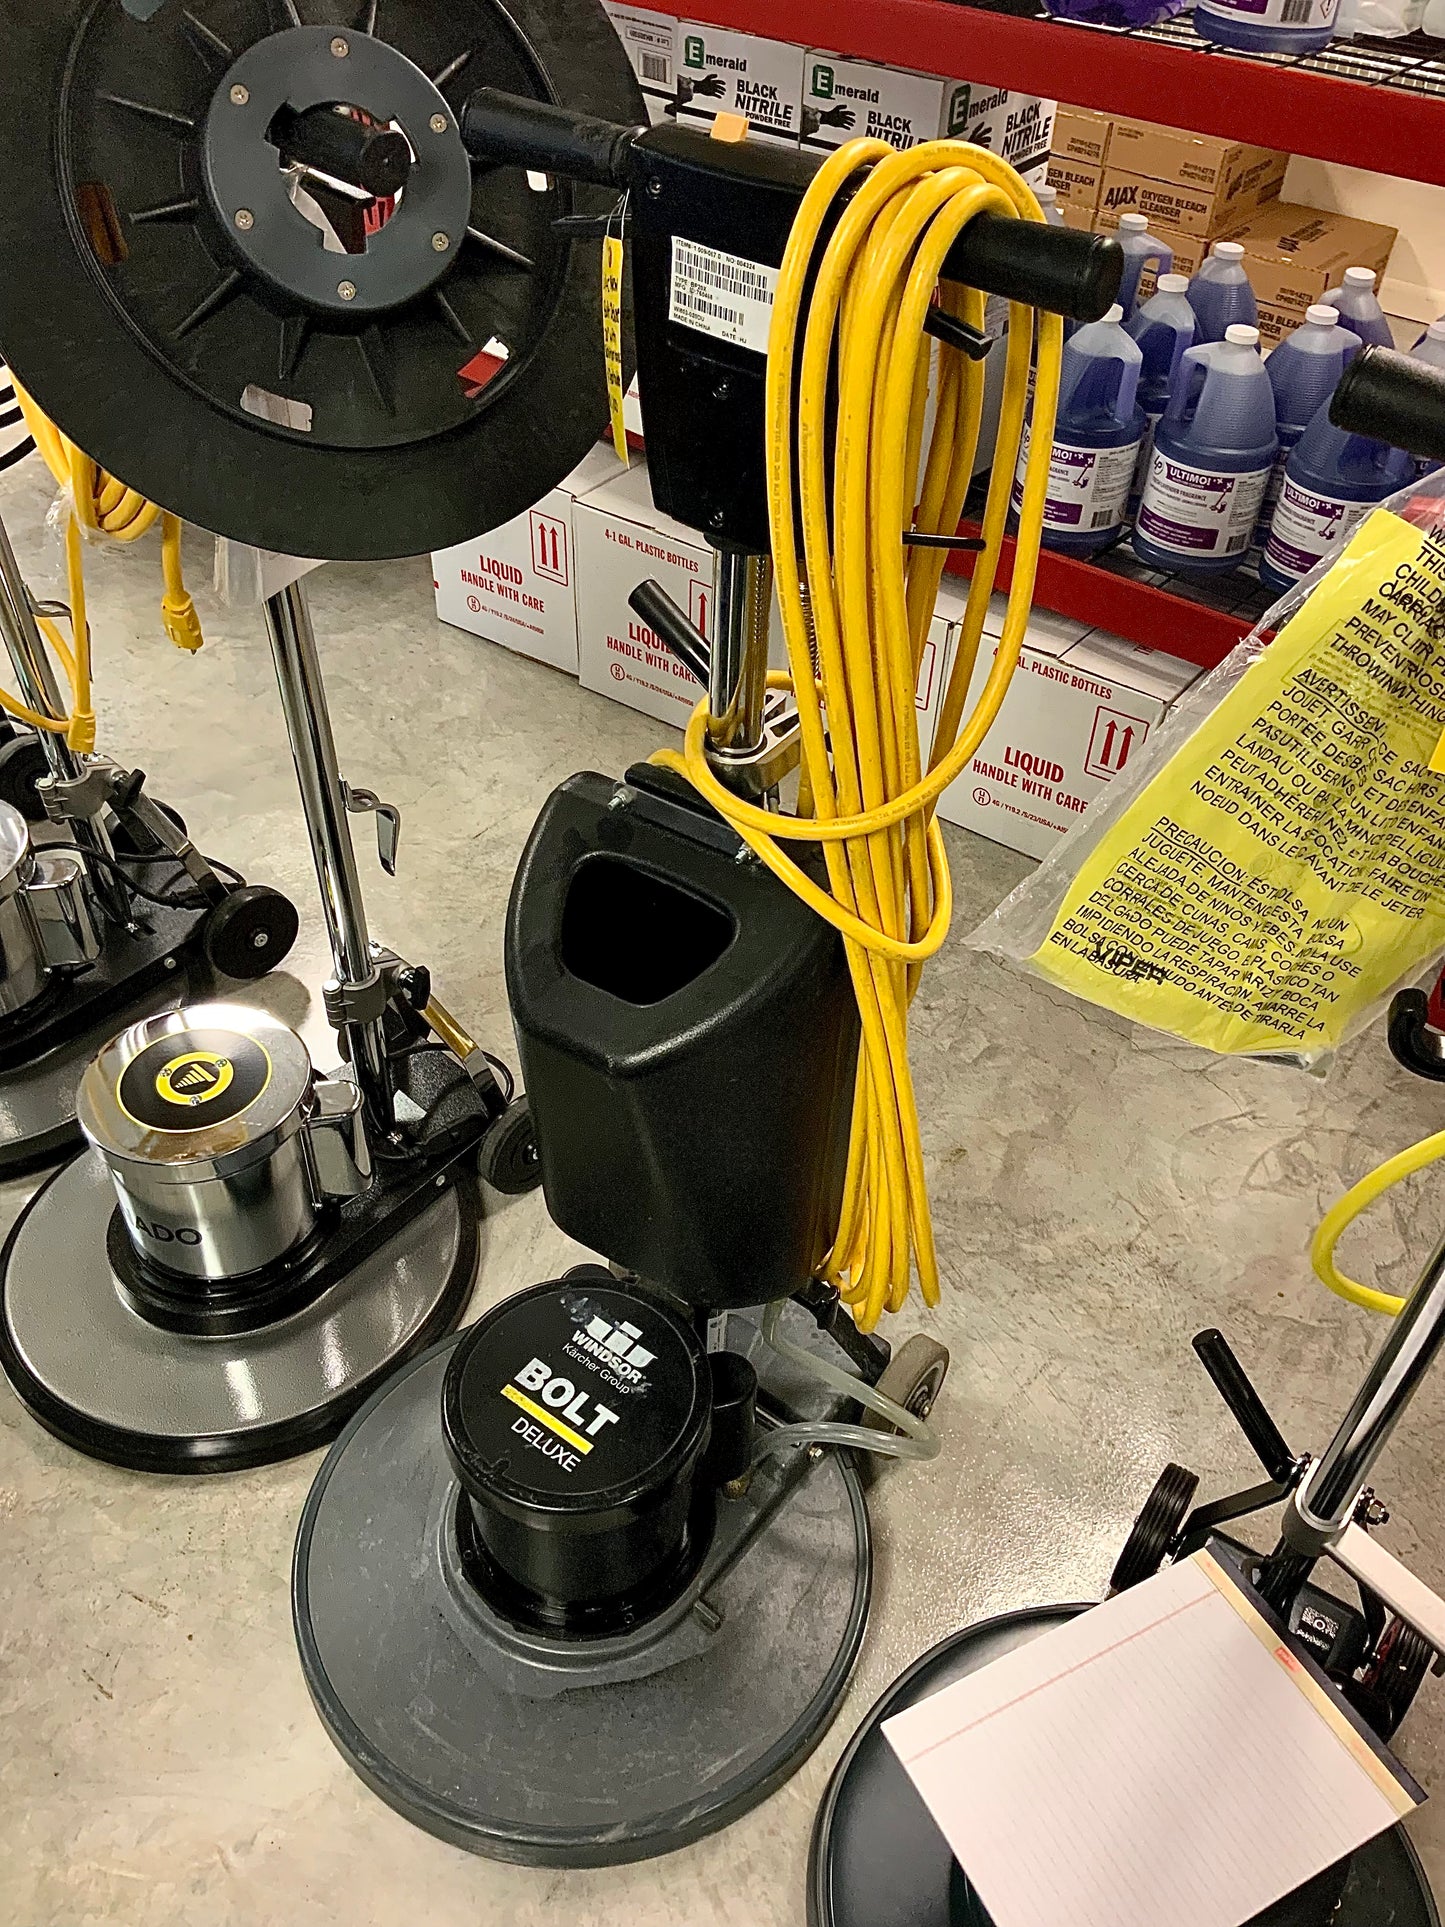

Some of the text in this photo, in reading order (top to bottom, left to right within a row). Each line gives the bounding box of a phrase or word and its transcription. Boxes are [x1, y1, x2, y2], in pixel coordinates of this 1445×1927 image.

[686, 38, 747, 73] Emerald
[736, 79, 778, 100] BLACK
[814, 66, 879, 104] Emerald
[735, 93, 793, 121] NITRILE
[745, 111, 791, 128] POWDER FREE
[867, 110, 912, 133] BLACK
[1006, 102, 1042, 133] BLACK
[1001, 116, 1052, 157] NITRILE
[1033, 138, 1048, 154] FREE
[1045, 177, 1071, 191] ANSER
[1048, 168, 1095, 187] GEN BLEACH
[1104, 185, 1207, 214] AJAX OXYGEN BLEACH
[1139, 202, 1181, 218] CLEANSER
[1258, 310, 1304, 330] GEN BLEAC
[1259, 322, 1281, 336] NSER
[1052, 448, 1072, 461] MO!
[1170, 466, 1212, 486] ULTIMO!
[1286, 486, 1320, 510] ULTIMO!
[605, 529, 699, 573] 4-1 GAL. PLASTIC BOTTLES
[480, 554, 523, 586] LIQUID
[460, 569, 545, 613] HANDLE WITH CARE
[1396, 563, 1445, 615] CHILD
[1361, 598, 1398, 626] MAY
[607, 636, 643, 662] HANDLE
[645, 652, 669, 673] WITH
[629, 622, 673, 656] LIQUI
[1032, 660, 1069, 684] PLASTIC
[1071, 675, 1112, 700] BOTTLES
[1267, 700, 1327, 748] PORTÉE
[1363, 786, 1389, 805] ET
[1282, 686, 1333, 723] JOUET.
[1373, 769, 1407, 792] SAC
[972, 759, 1018, 788] HANDLE
[1021, 778, 1052, 801] WITH
[1004, 746, 1064, 783] LIQUID
[1220, 749, 1261, 776] PEUT
[1235, 733, 1294, 775] LANDAU
[1291, 774, 1318, 796] OU
[1331, 796, 1353, 821] LA
[1350, 796, 1372, 820] UN
[1205, 765, 1285, 827] ENTRAINER
[1368, 868, 1414, 897] FAIRE
[1142, 832, 1207, 879] JUGUETE.
[1190, 780, 1240, 814] NOEUD
[1238, 811, 1281, 847] DANS
[1304, 854, 1348, 893] AVANT
[1361, 884, 1384, 901] LE
[1381, 898, 1425, 920] JETER.
[1155, 816, 1249, 884] PRECAUCION:
[1327, 918, 1350, 932] UN
[1117, 862, 1161, 893] CERCA
[1158, 886, 1184, 907] DE
[1182, 904, 1230, 938] CUNAS,
[1322, 971, 1335, 982] O
[1128, 847, 1187, 888] ALEJADA
[1185, 881, 1211, 904] DE
[1207, 898, 1253, 927] NINOS
[1310, 948, 1329, 962] LA
[1329, 955, 1363, 978] USE
[1050, 931, 1073, 949] EN
[1070, 941, 1089, 958] LA
[1088, 891, 1153, 930] DELGADO
[1151, 927, 1200, 956] PUEDE
[1198, 950, 1241, 981] TAPAR
[1280, 983, 1319, 1017] BOCA
[1103, 877, 1176, 924] CORRALES
[1172, 920, 1196, 936] DE
[1192, 930, 1240, 960] JUEGO.
[1310, 982, 1340, 1003] TAN
[1076, 905, 1154, 953] IMPIDIENDO
[1152, 948, 1171, 962] LA
[1306, 1017, 1325, 1032] LA
[1232, 1003, 1254, 1022] DE
[1253, 1014, 1306, 1040] TIRARLA
[136, 1216, 202, 1245] ADO
[562, 1343, 630, 1395] Kärcher Group
[572, 1329, 643, 1384] WINDSOR
[514, 1357, 620, 1436] BOLT
[511, 1417, 581, 1473] DELUXE
